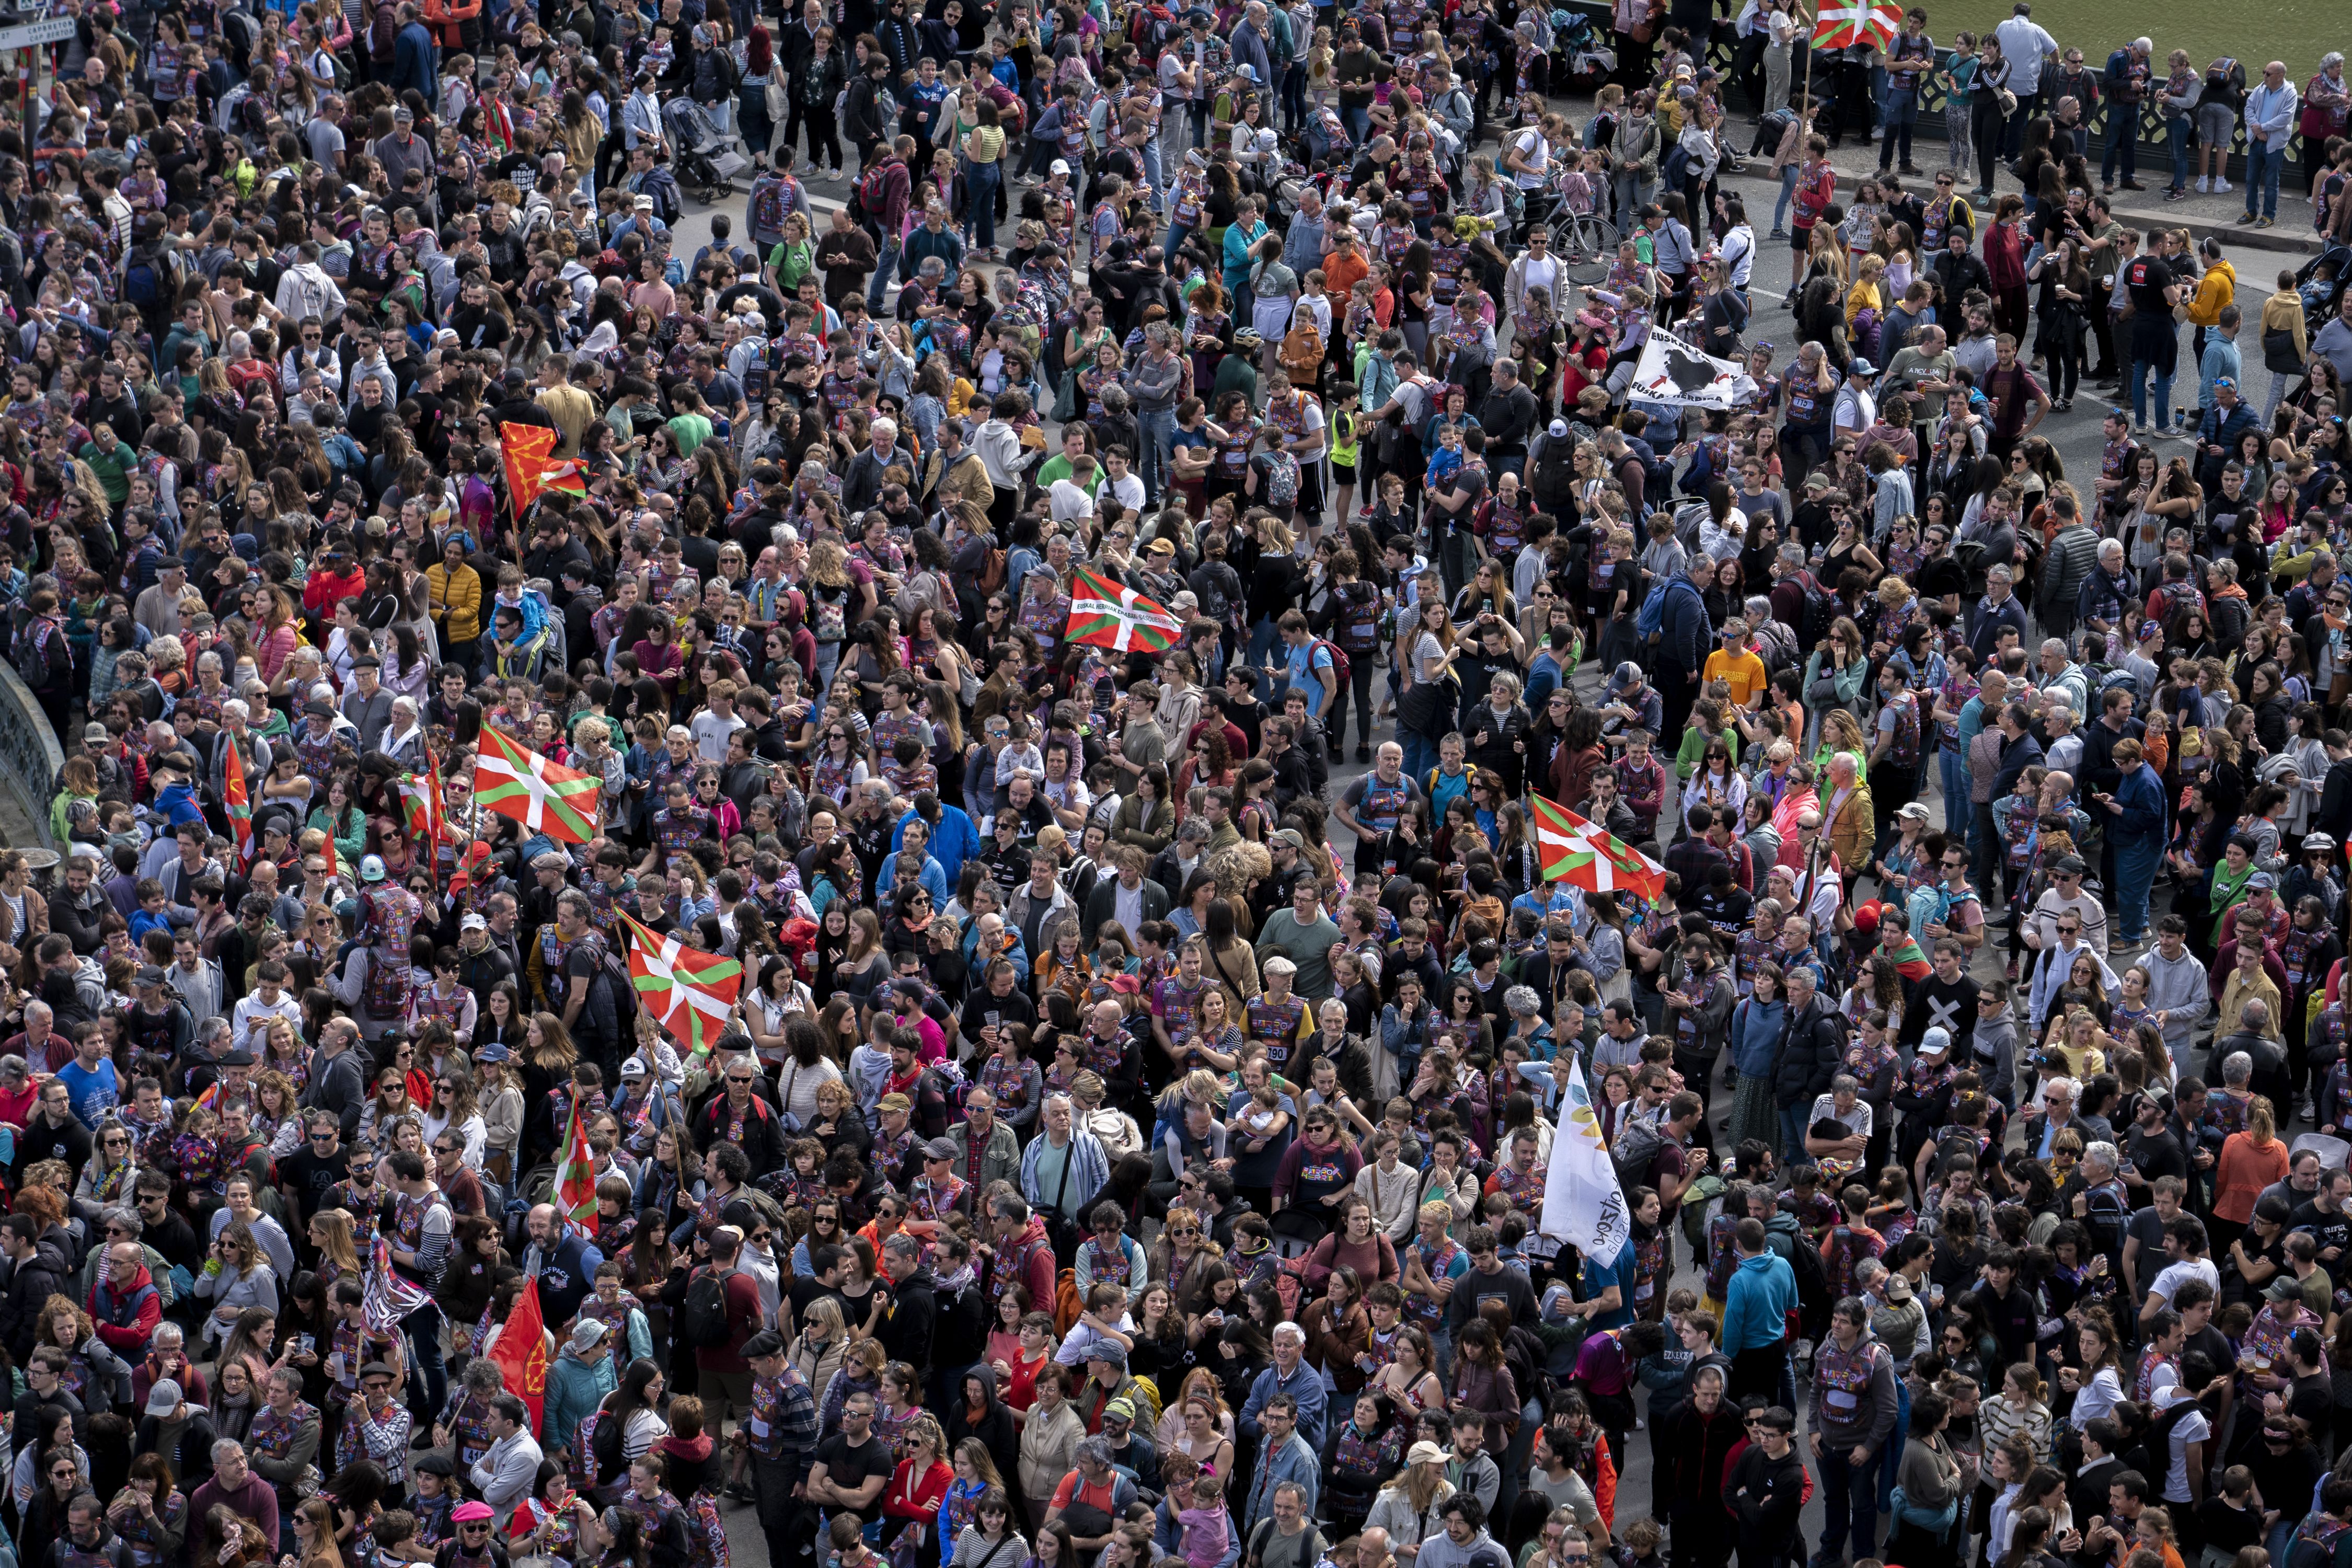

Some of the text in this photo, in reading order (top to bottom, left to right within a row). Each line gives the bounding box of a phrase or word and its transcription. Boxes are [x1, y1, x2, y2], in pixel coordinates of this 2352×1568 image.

[28, 20, 73, 34] CAPBRETON
[29, 29, 73, 42] CAP BERTON
[1651, 331, 1693, 355] EUSKAL
[1631, 381, 1666, 399] EUSKA
[1096, 604, 1116, 613] HERRIAK
[1252, 1019, 1288, 1030] HARRO
[540, 1266, 570, 1281] OLFPACK
[1821, 1368, 1859, 1381] HARRO
